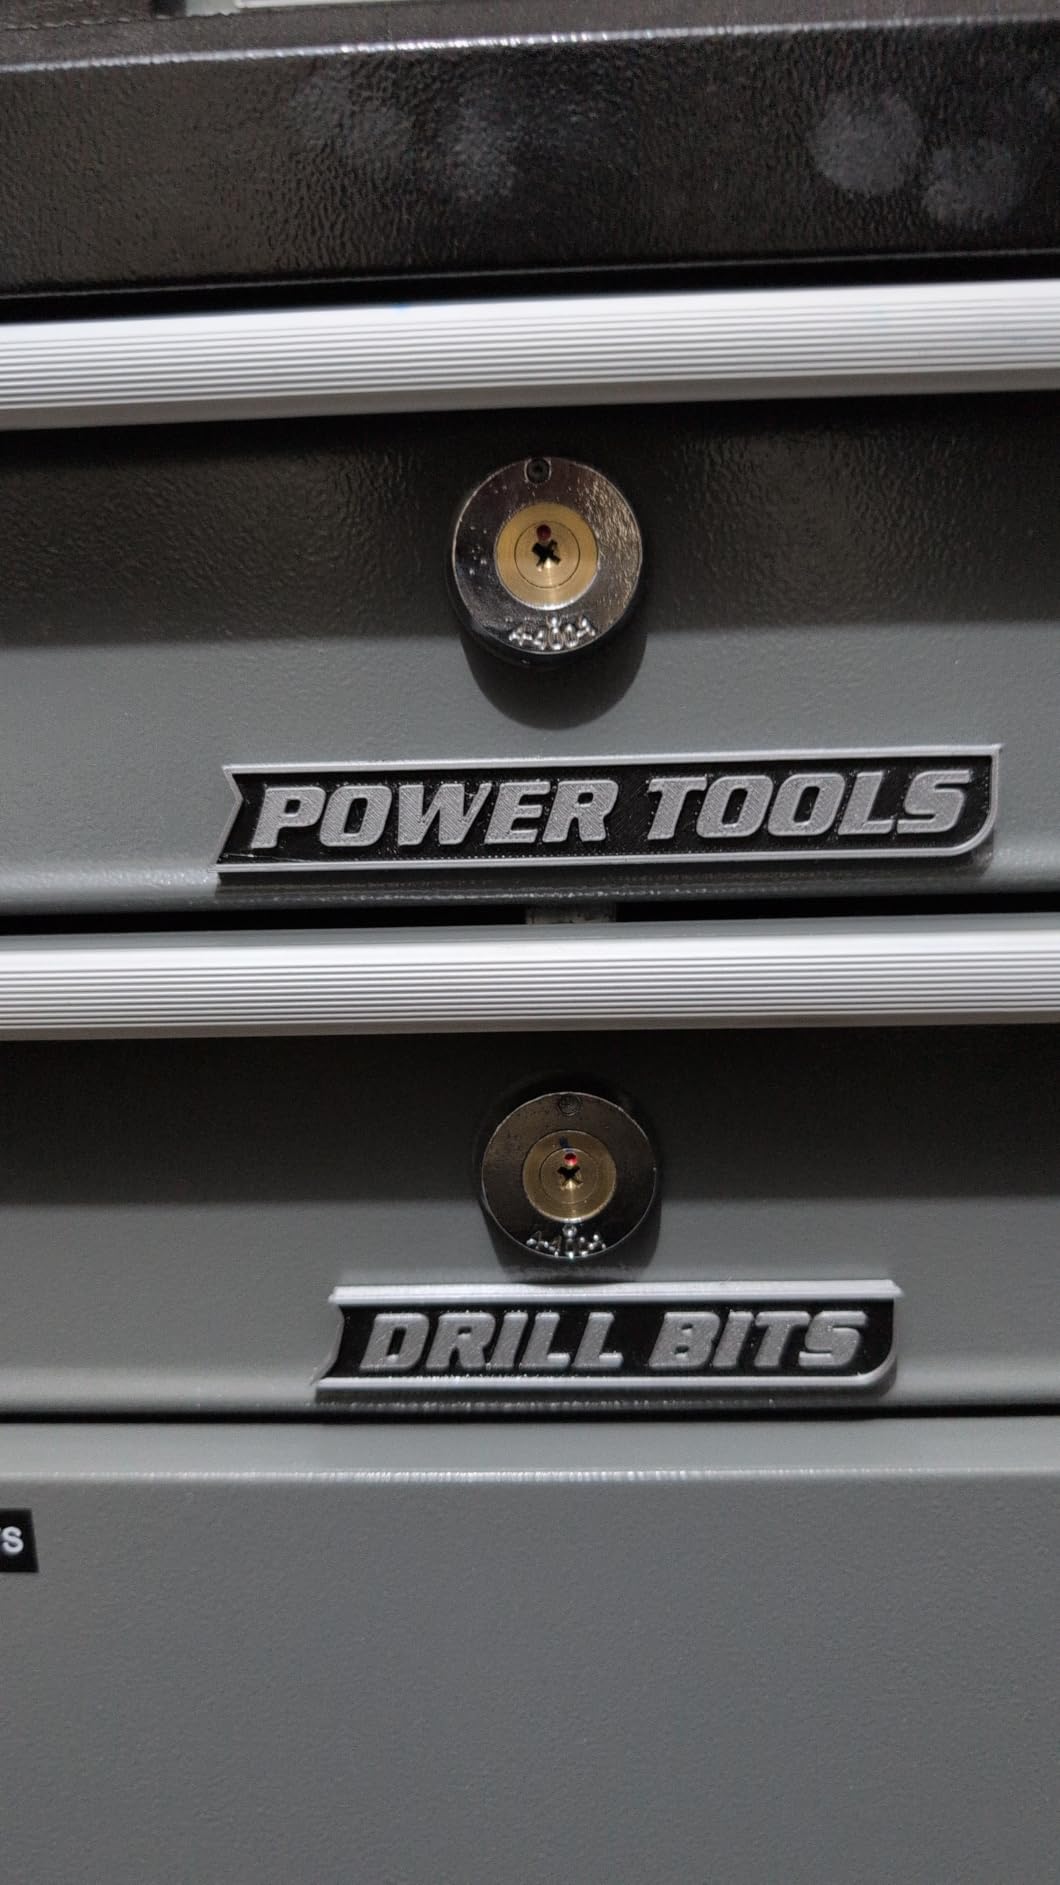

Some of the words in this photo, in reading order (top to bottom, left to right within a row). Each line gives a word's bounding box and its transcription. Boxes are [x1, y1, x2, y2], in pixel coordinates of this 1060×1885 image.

[251, 780, 618, 849] POWER
[647, 769, 971, 840] TOOLS
[359, 1310, 623, 1371] DRILL
[648, 1309, 868, 1369] BITS
[0, 1526, 24, 1554] S
